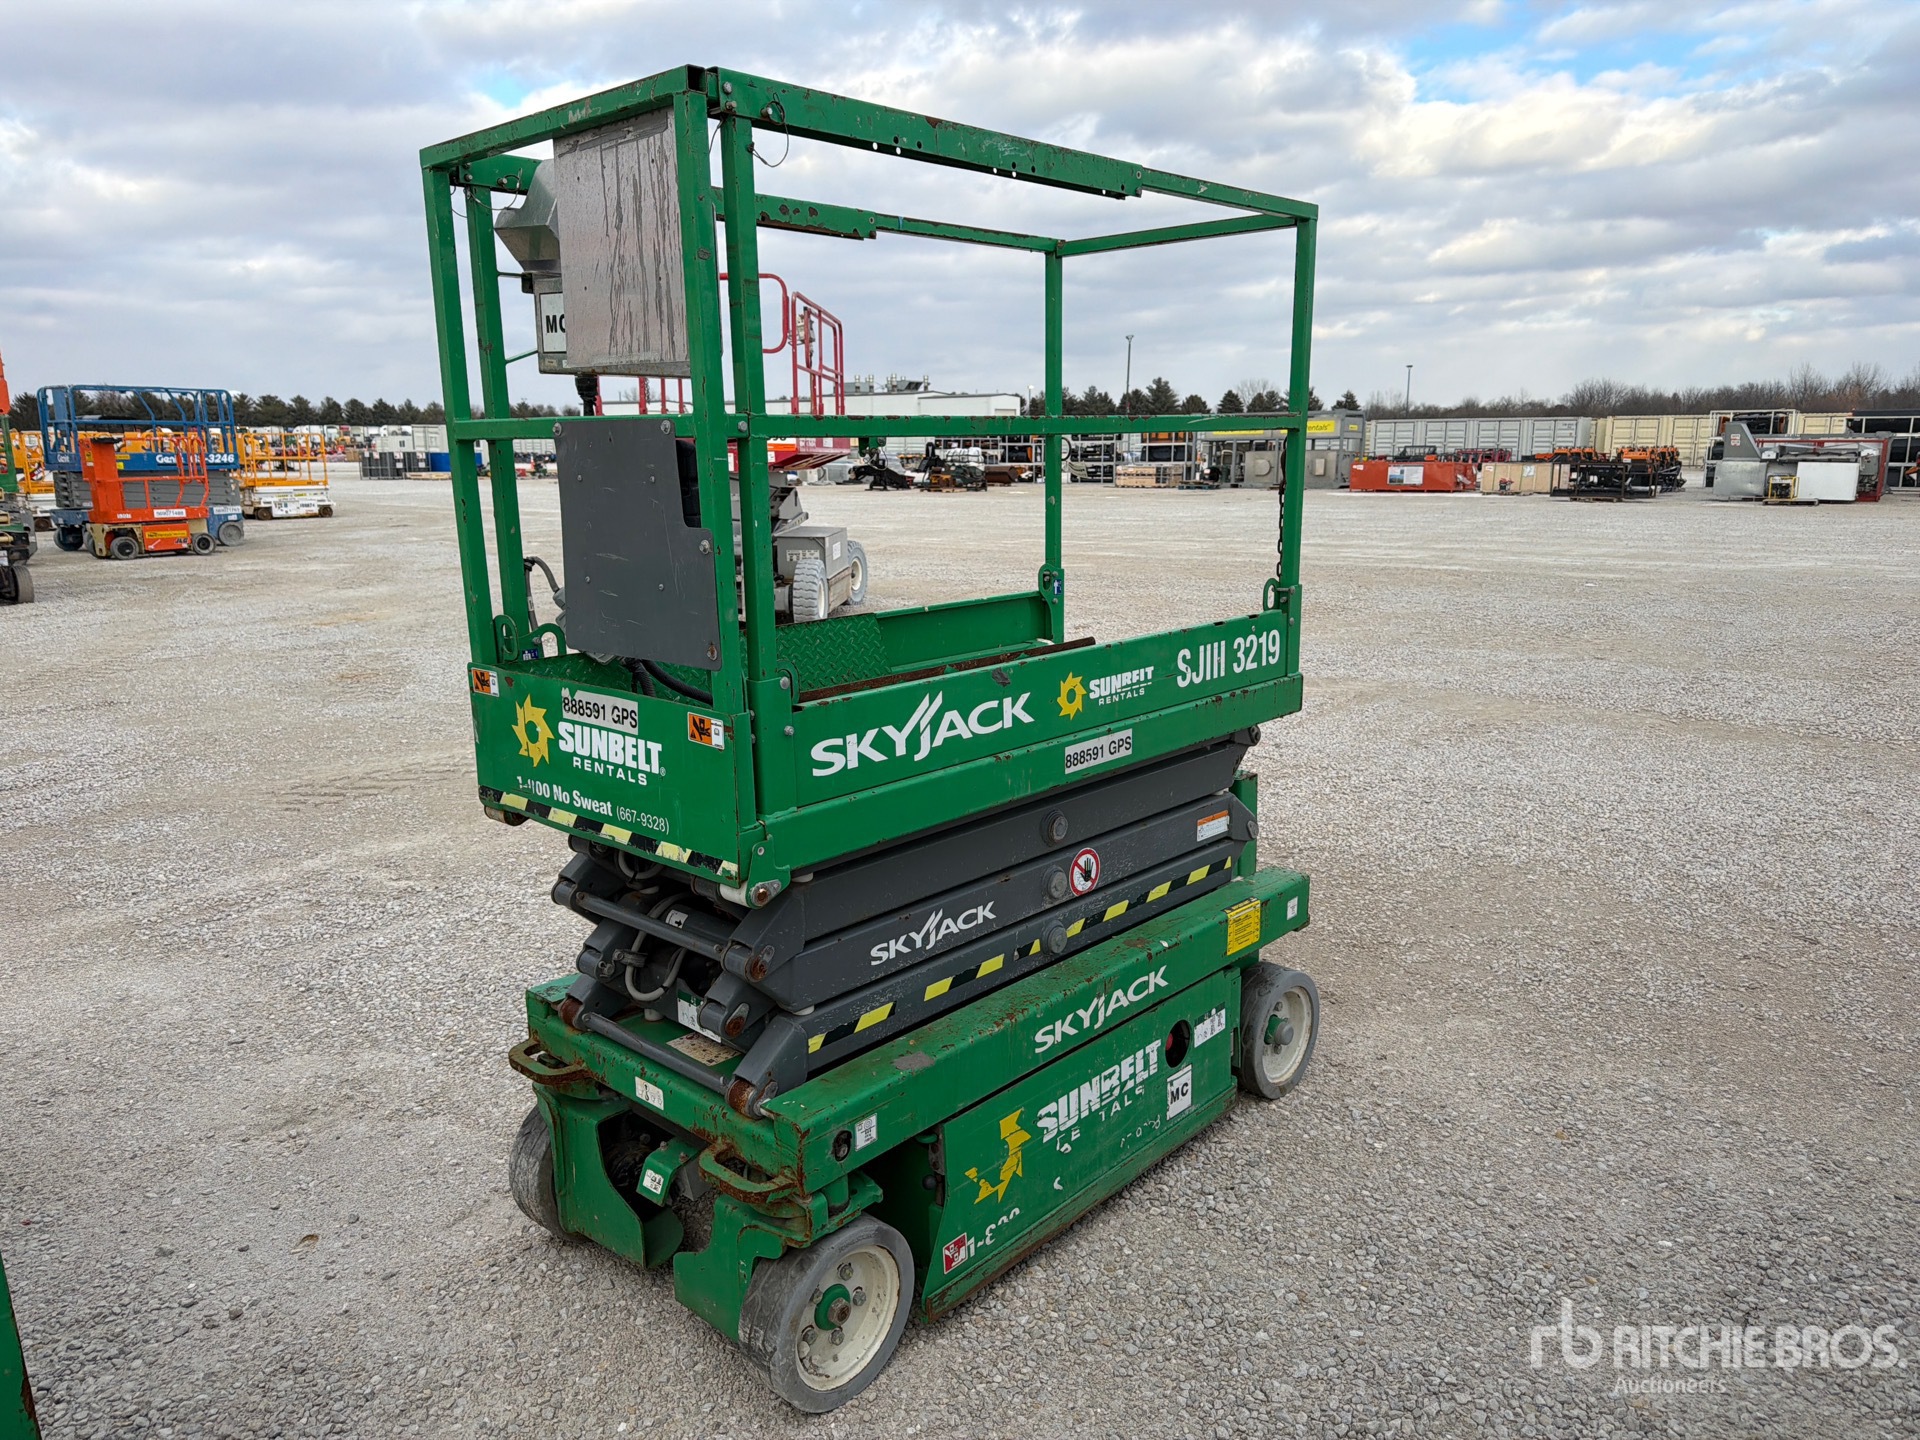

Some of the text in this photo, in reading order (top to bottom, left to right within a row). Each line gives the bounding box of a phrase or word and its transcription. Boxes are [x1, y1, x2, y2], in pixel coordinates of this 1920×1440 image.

[1306, 423, 1329, 432] entals
[1232, 629, 1280, 674] 3219
[562, 696, 638, 729] 888591 GPS
[1098, 687, 1145, 706] RENTALS
[557, 721, 663, 775] SUNBELT
[809, 690, 1034, 777] SKYJACK
[1065, 735, 1133, 769] 888591 GPS
[572, 756, 648, 786] RENTALS
[552, 783, 570, 804] No
[572, 789, 613, 817] Sweat
[616, 804, 670, 835] (667-9328)
[870, 901, 997, 966] SKYJACK
[1034, 964, 1169, 1054] SKYJACK
[1170, 1082, 1189, 1105] MC
